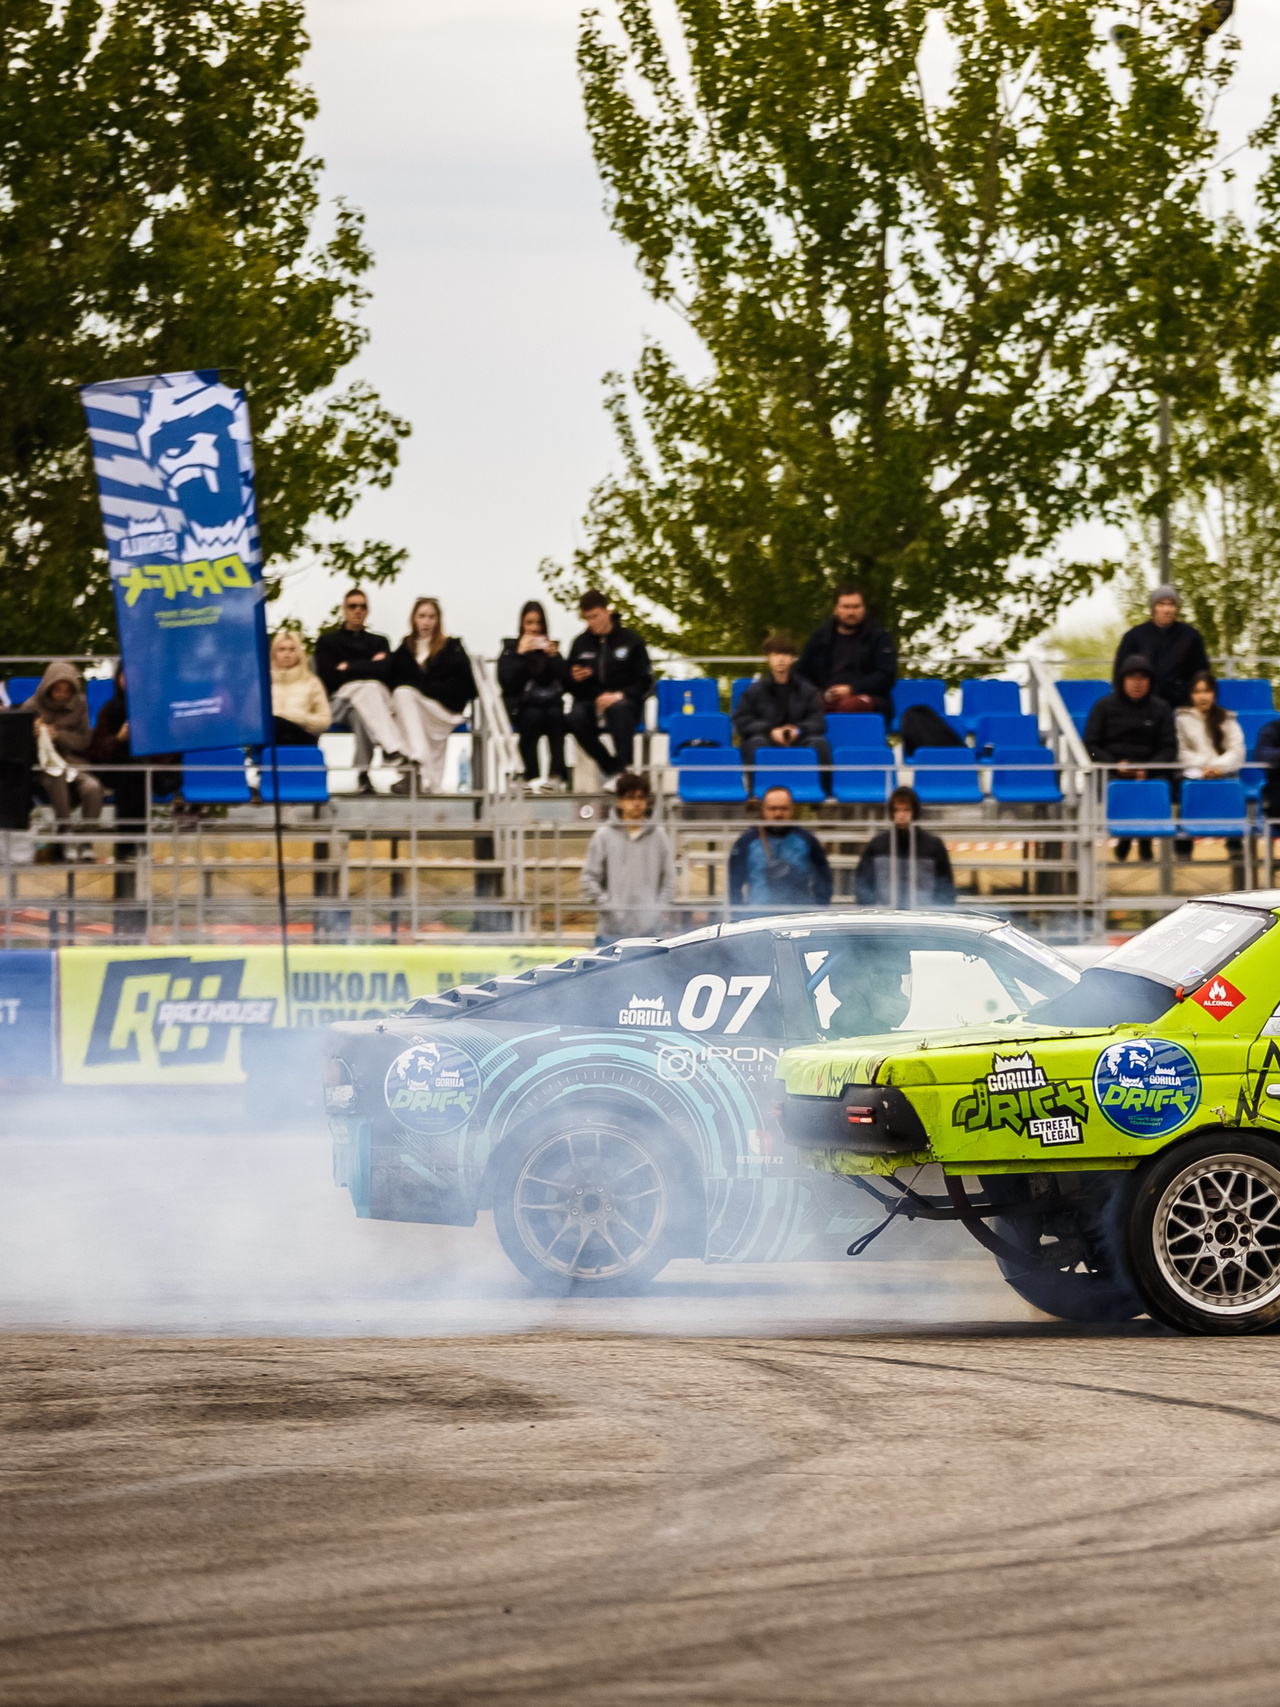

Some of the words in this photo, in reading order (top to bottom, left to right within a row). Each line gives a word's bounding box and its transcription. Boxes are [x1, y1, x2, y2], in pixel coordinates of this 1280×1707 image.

[290, 971, 411, 1002] ШКОЛА
[157, 1000, 274, 1025] RACEHOUSE
[678, 973, 772, 1034] 07
[618, 1009, 672, 1027] GORILLA
[701, 1046, 784, 1062] IRON
[435, 1078, 464, 1088] GORILLA
[986, 1069, 1047, 1092] GORILLA
[1149, 1075, 1181, 1086] GORILLA
[1101, 1084, 1192, 1116] DRIFT
[1033, 1118, 1071, 1133] STREET
[1045, 1129, 1077, 1142] LEGAL
